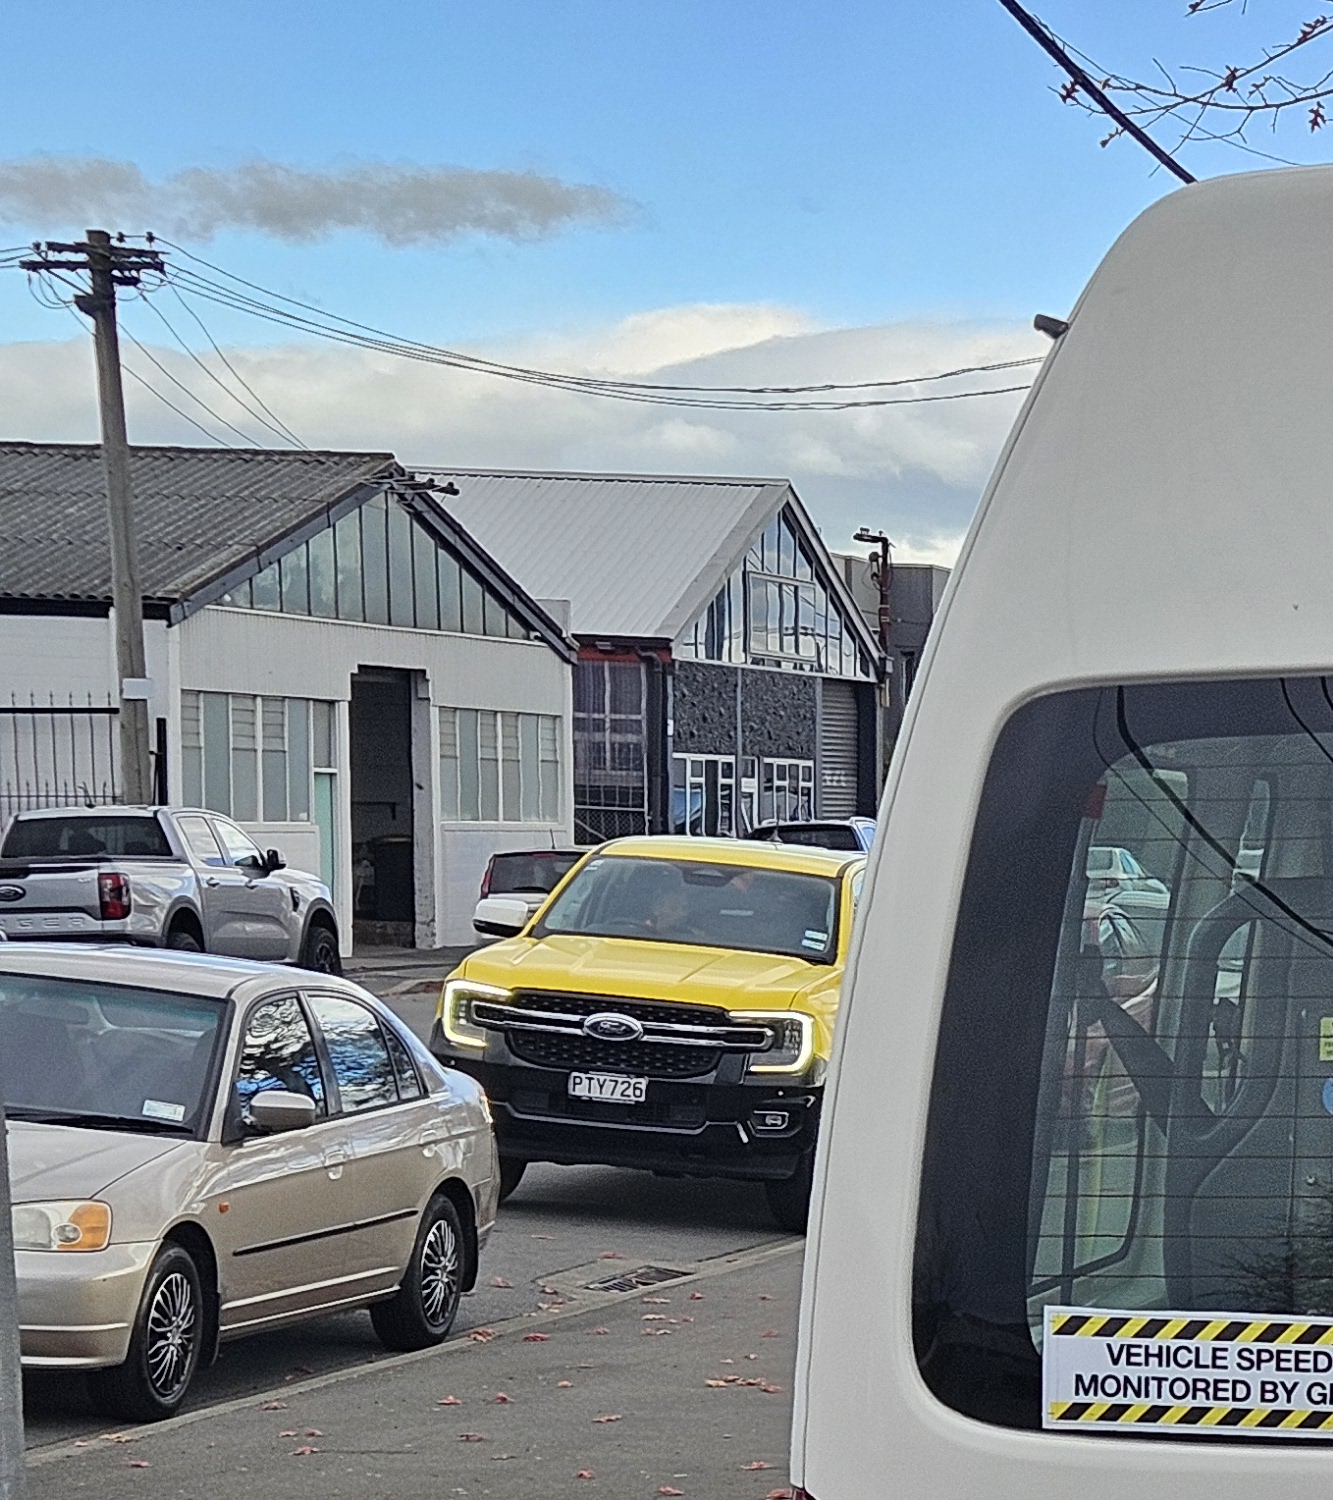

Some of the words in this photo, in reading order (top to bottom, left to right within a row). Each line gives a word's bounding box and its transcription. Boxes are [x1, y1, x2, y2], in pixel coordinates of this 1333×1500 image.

[572, 1075, 644, 1098] PTY726
[1105, 1343, 1229, 1370] VEHICLE
[1236, 1348, 1333, 1373] SPEED
[1074, 1374, 1250, 1402] MONITORED
[1259, 1380, 1300, 1405] BY
